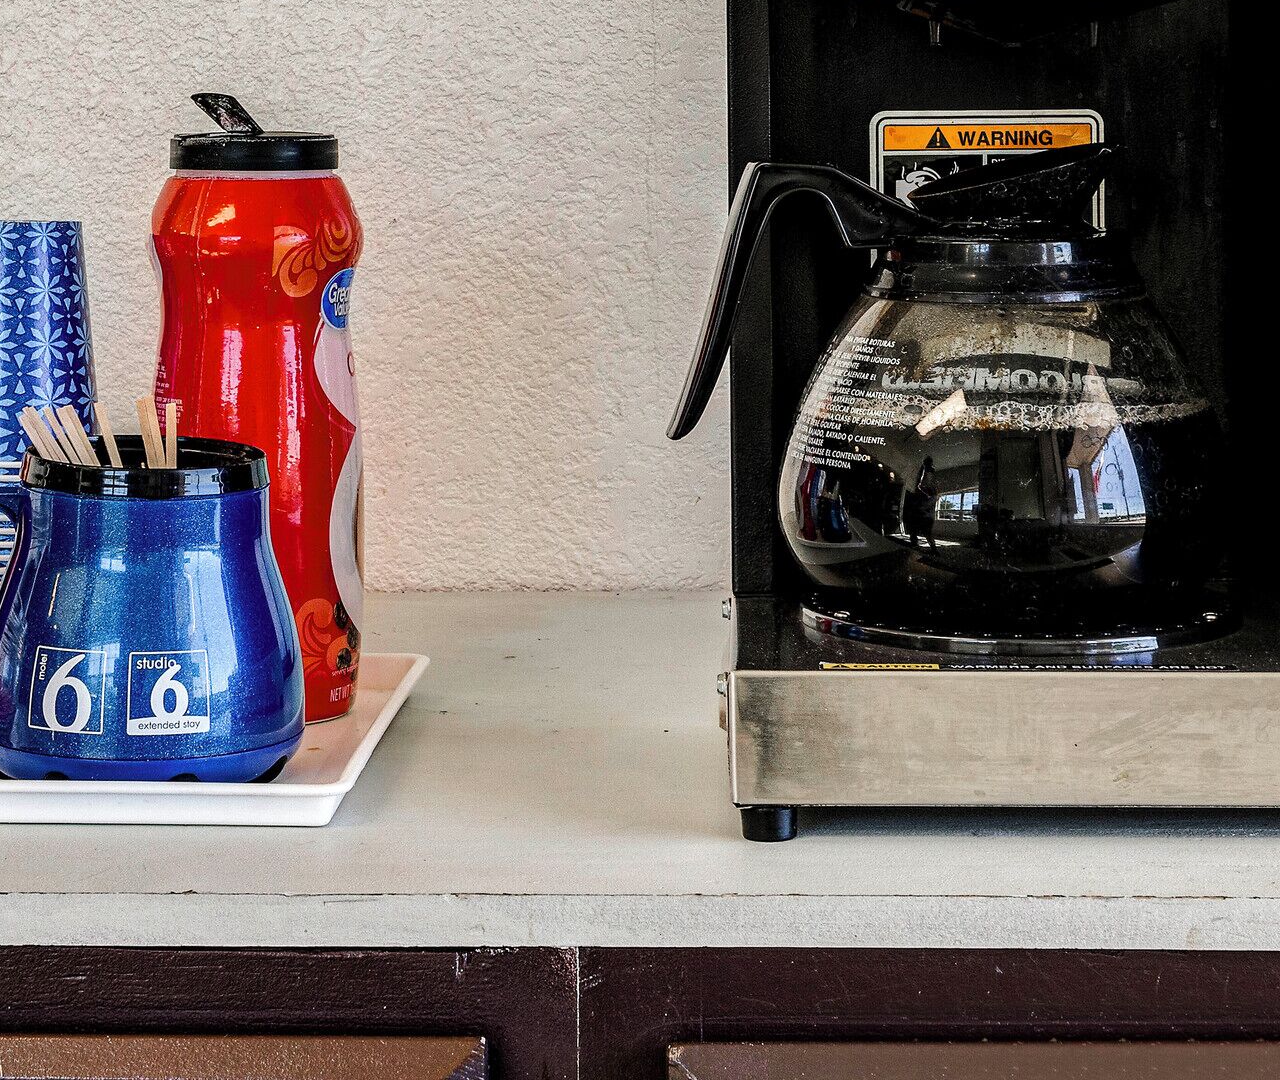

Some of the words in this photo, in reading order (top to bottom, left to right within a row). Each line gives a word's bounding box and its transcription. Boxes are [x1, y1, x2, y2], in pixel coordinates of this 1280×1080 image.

[957, 130, 1053, 147] WARNING
[869, 339, 896, 348] ROTURAS
[870, 355, 901, 365] LIQUIDOS
[844, 370, 869, 380] CALENTAR
[851, 389, 865, 397] CON
[865, 390, 903, 401] MATERIALES
[850, 407, 896, 418] DIRECTAMENTE
[860, 418, 893, 428] HORNILLA
[826, 431, 847, 441] RAYADO
[854, 435, 886, 446] CALIENTE,
[832, 450, 867, 462] CONTENIDO
[826, 457, 851, 469] PERSONA
[136, 656, 177, 670] studio
[43, 653, 92, 732] 6
[150, 664, 189, 719] 6
[138, 721, 181, 730] extended
[182, 719, 201, 728] stay
